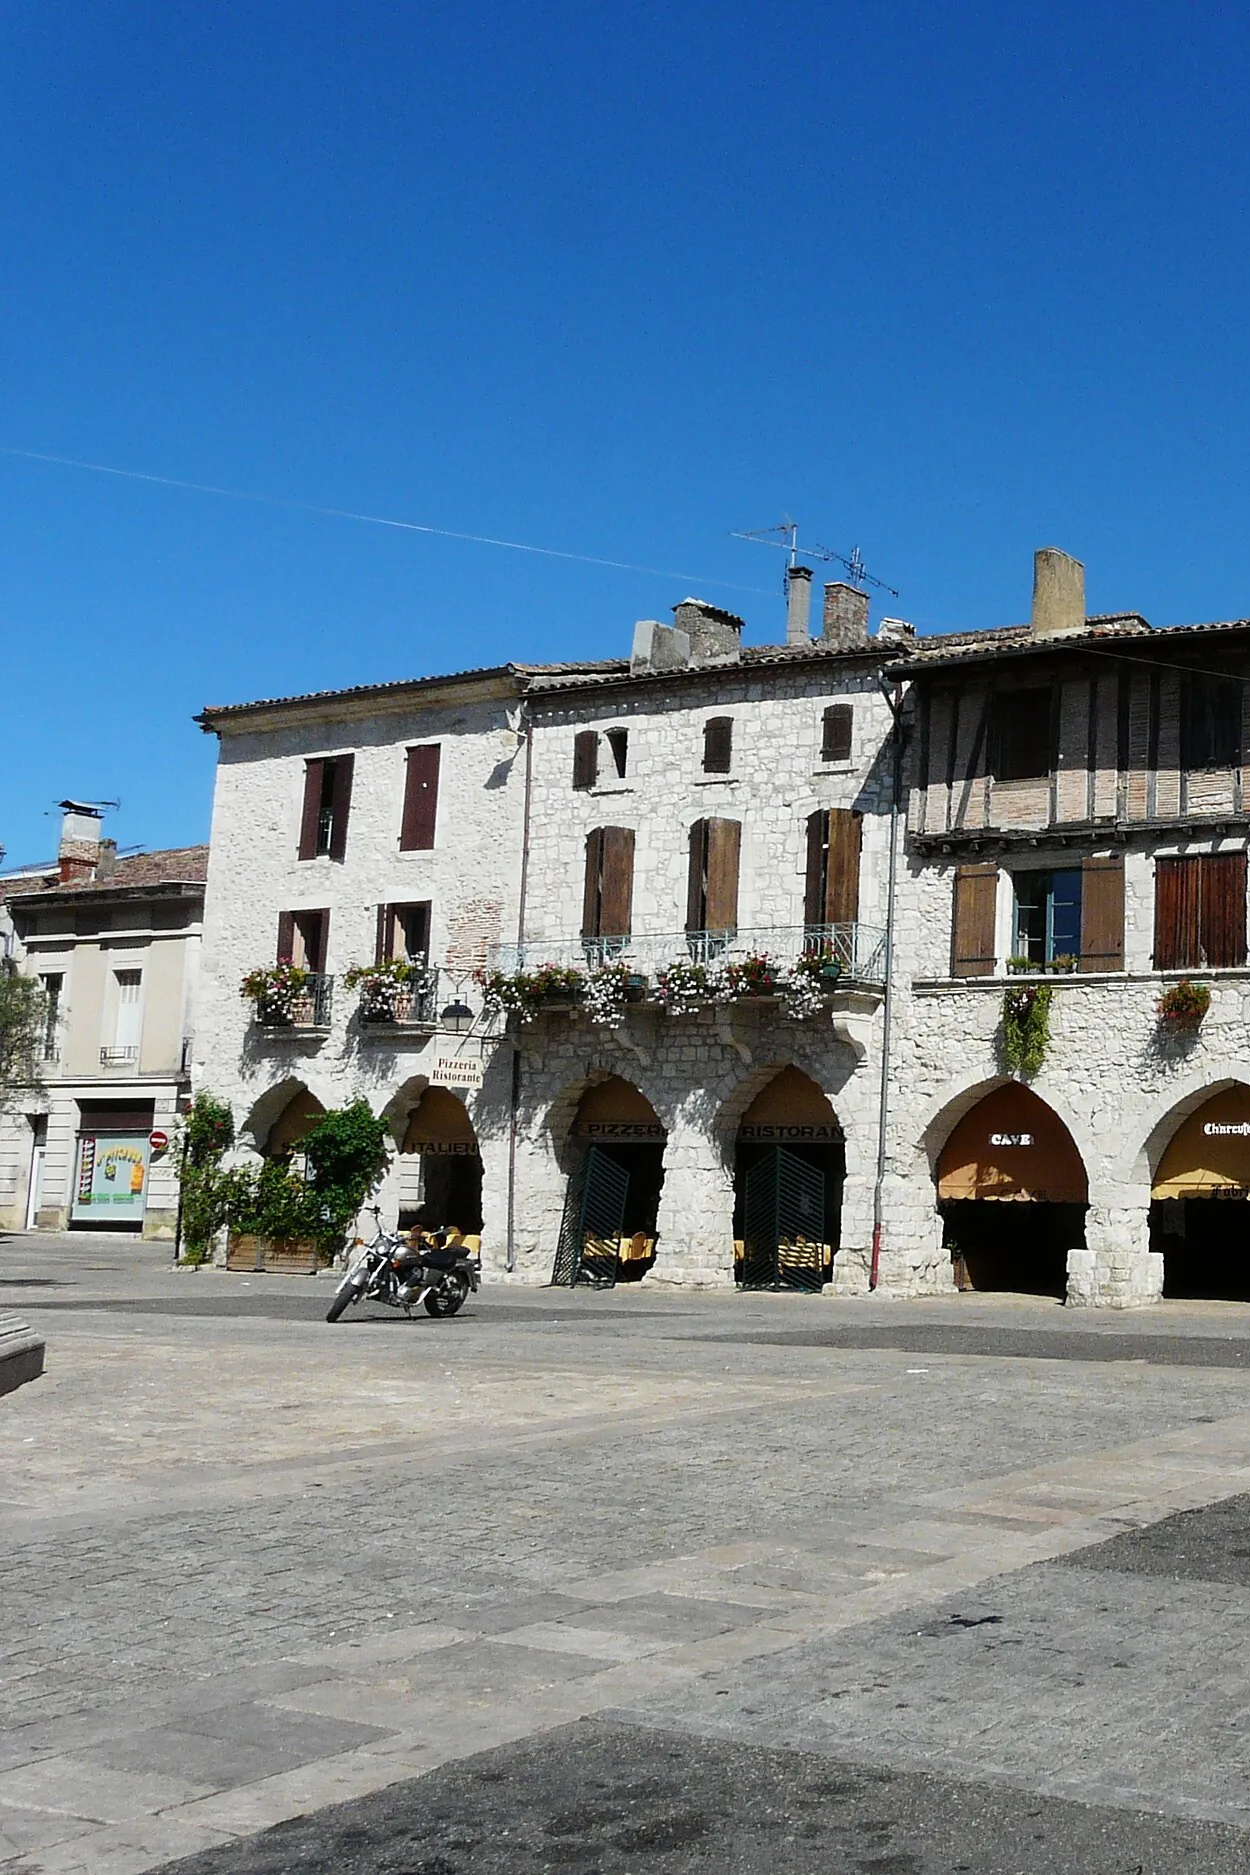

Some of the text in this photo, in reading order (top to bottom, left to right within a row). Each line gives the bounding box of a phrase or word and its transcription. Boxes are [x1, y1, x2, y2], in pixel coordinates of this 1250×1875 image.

[438, 1058, 477, 1071] Pizzeria
[432, 1070, 481, 1083] Ristorante
[991, 1133, 1031, 1146] CAVE
